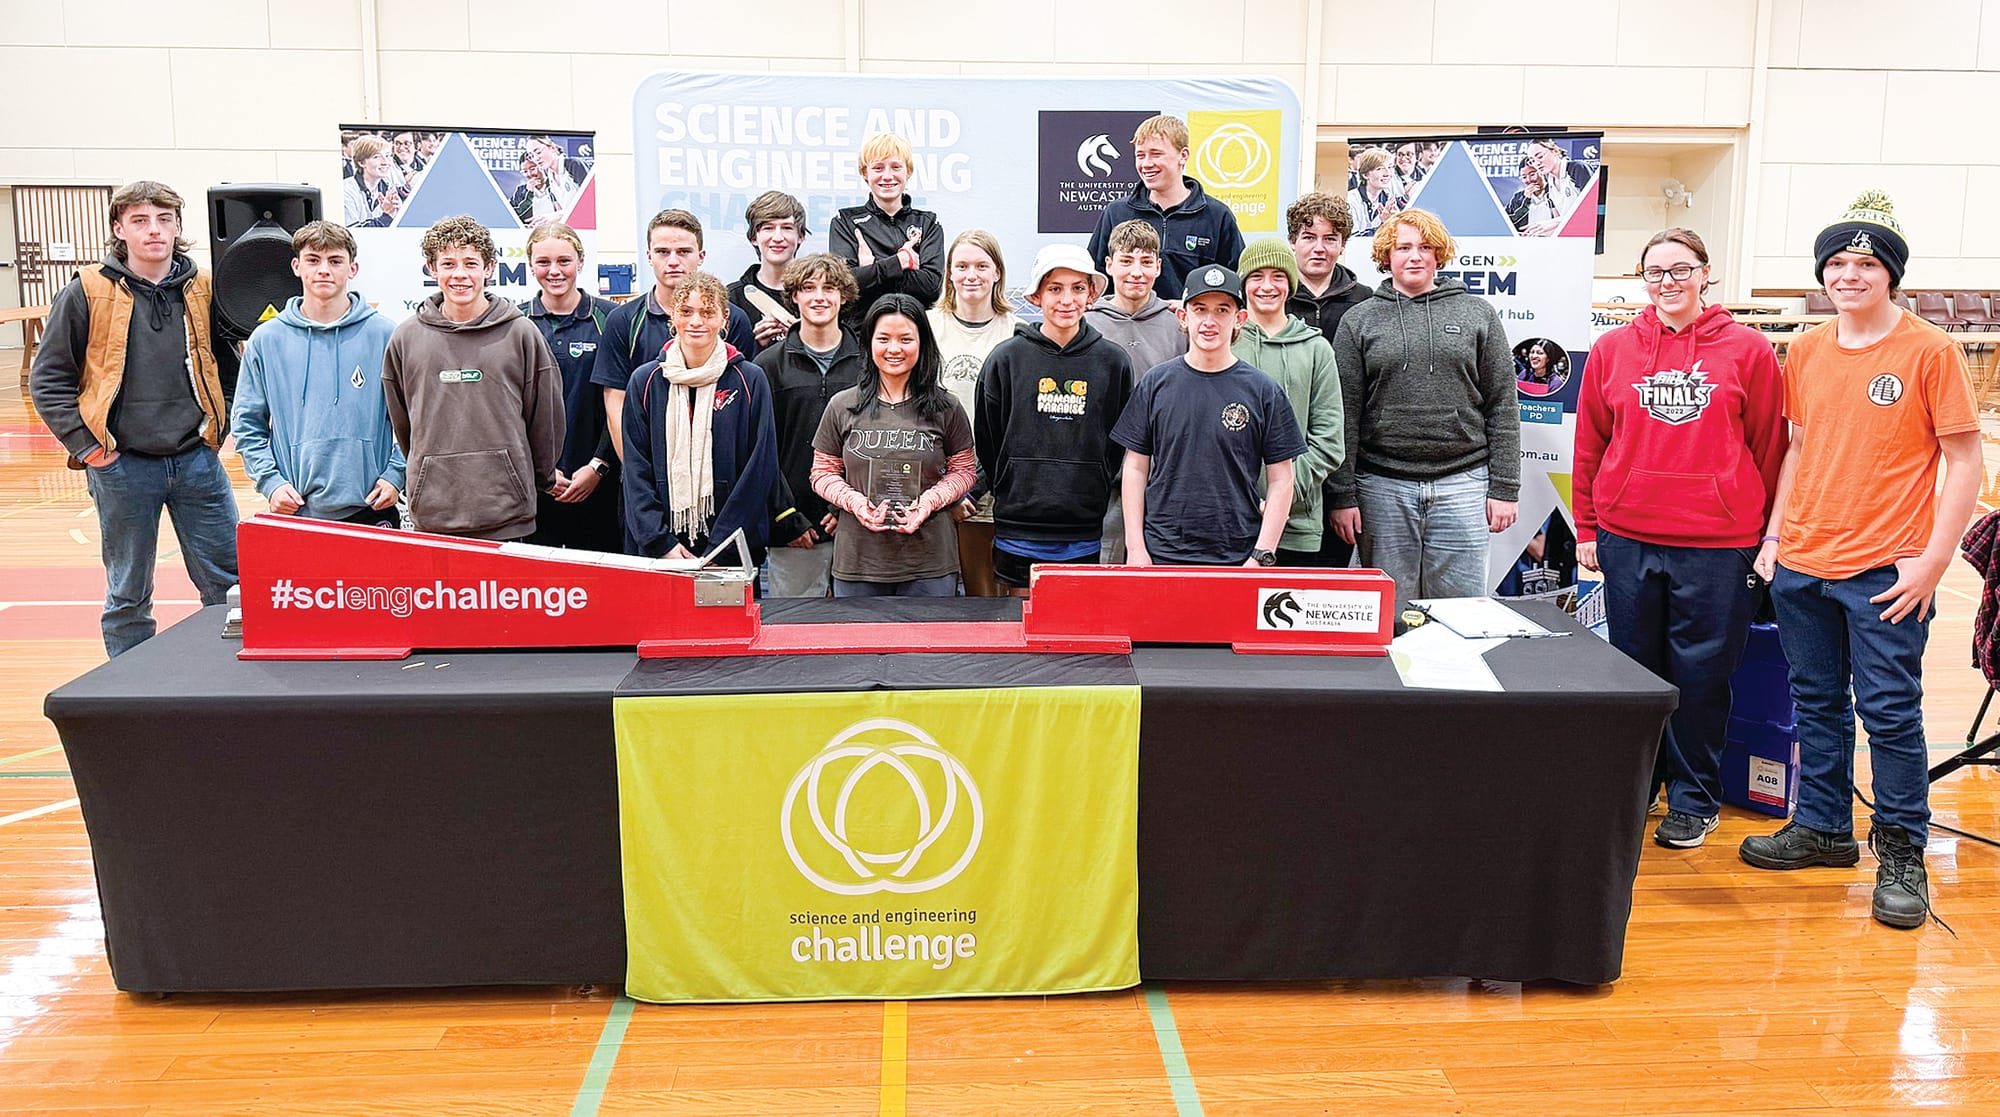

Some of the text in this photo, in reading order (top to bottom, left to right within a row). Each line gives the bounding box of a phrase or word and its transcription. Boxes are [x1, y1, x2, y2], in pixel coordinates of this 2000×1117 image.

[655, 101, 961, 148] SCIENCE AND
[1059, 190, 1133, 202] NEWCASTL
[1459, 255, 1495, 266] GEN
[1508, 309, 1535, 321] hub
[1037, 393, 1087, 405] NOMADIC
[1641, 386, 1709, 406] FINALS
[1037, 402, 1086, 415] PARADISE
[1518, 403, 1556, 413] Teachers
[1529, 412, 1544, 420] PD
[846, 428, 937, 460] QUEEN
[271, 579, 587, 617] #sciengchallenge
[1305, 610, 1373, 622] NEWCASTLE
[1757, 774, 1778, 785] A08
[790, 908, 977, 926] science and engineering
[791, 925, 977, 970] challenge
